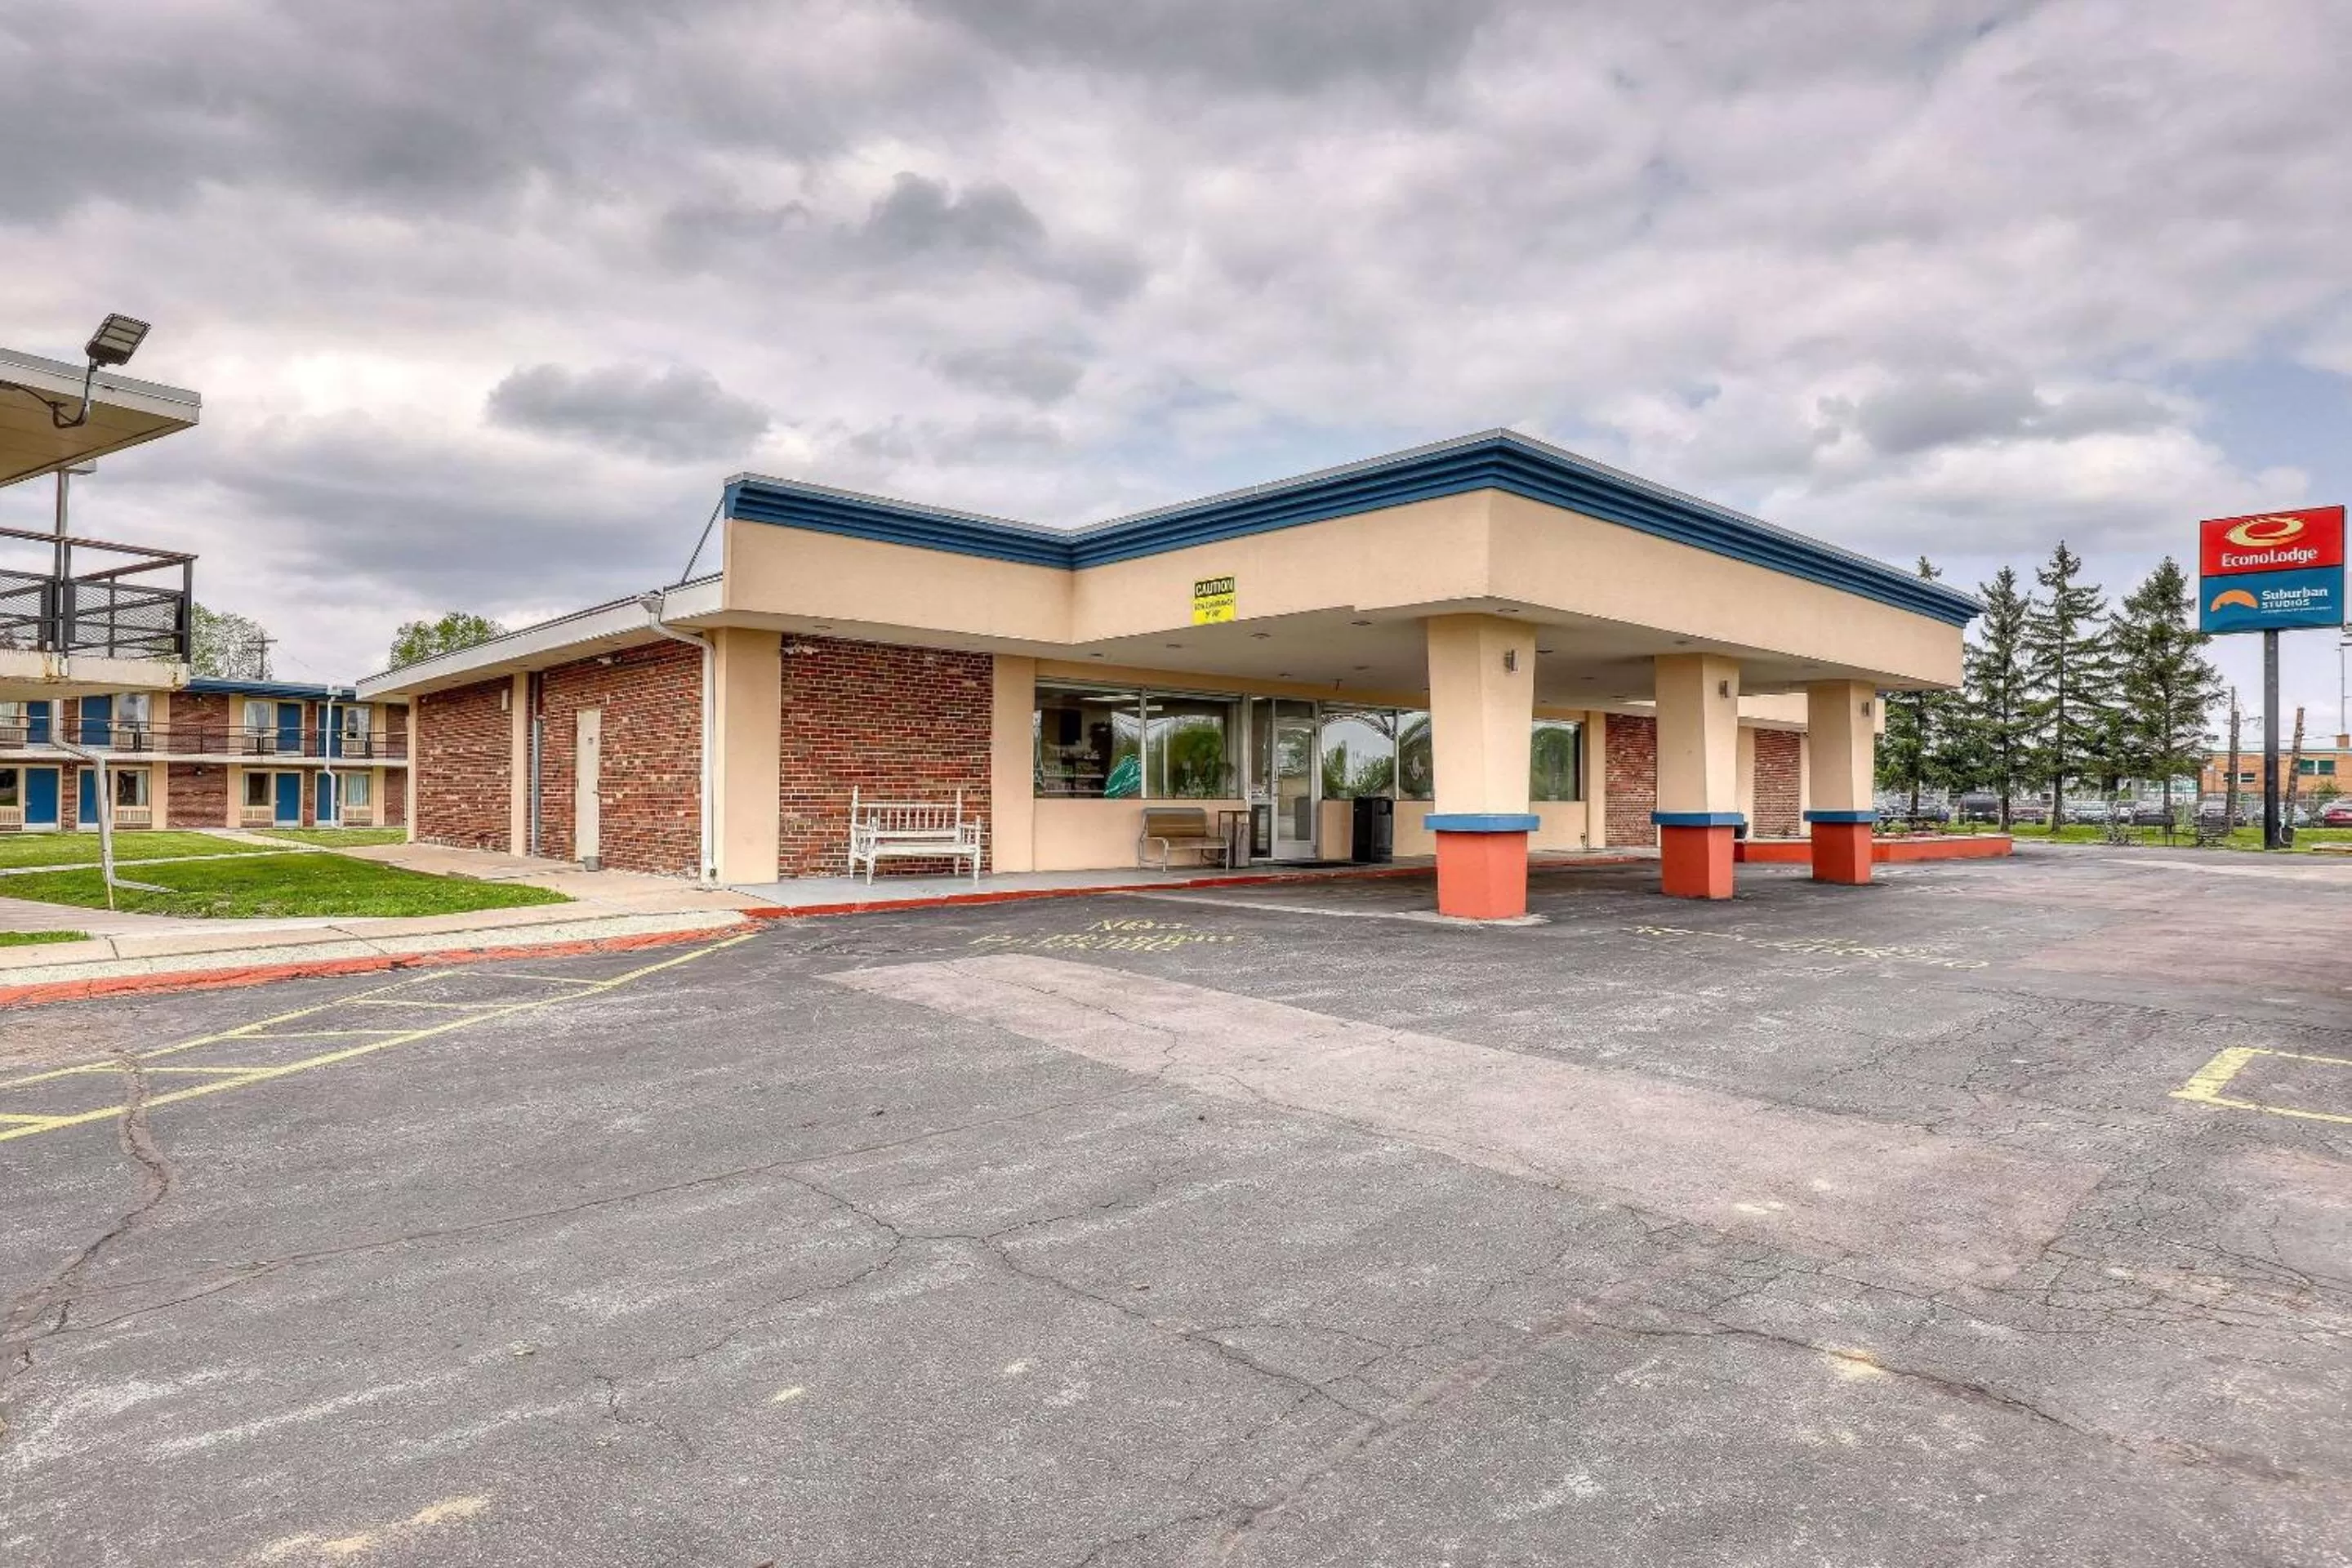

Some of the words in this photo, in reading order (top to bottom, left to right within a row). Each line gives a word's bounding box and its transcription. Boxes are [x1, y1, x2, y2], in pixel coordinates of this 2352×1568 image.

[2221, 546, 2319, 568] EconoLodge
[1196, 578, 1233, 596] CAUTION
[2261, 586, 2328, 600] Suburban
[2261, 598, 2310, 609] STUDIOS
